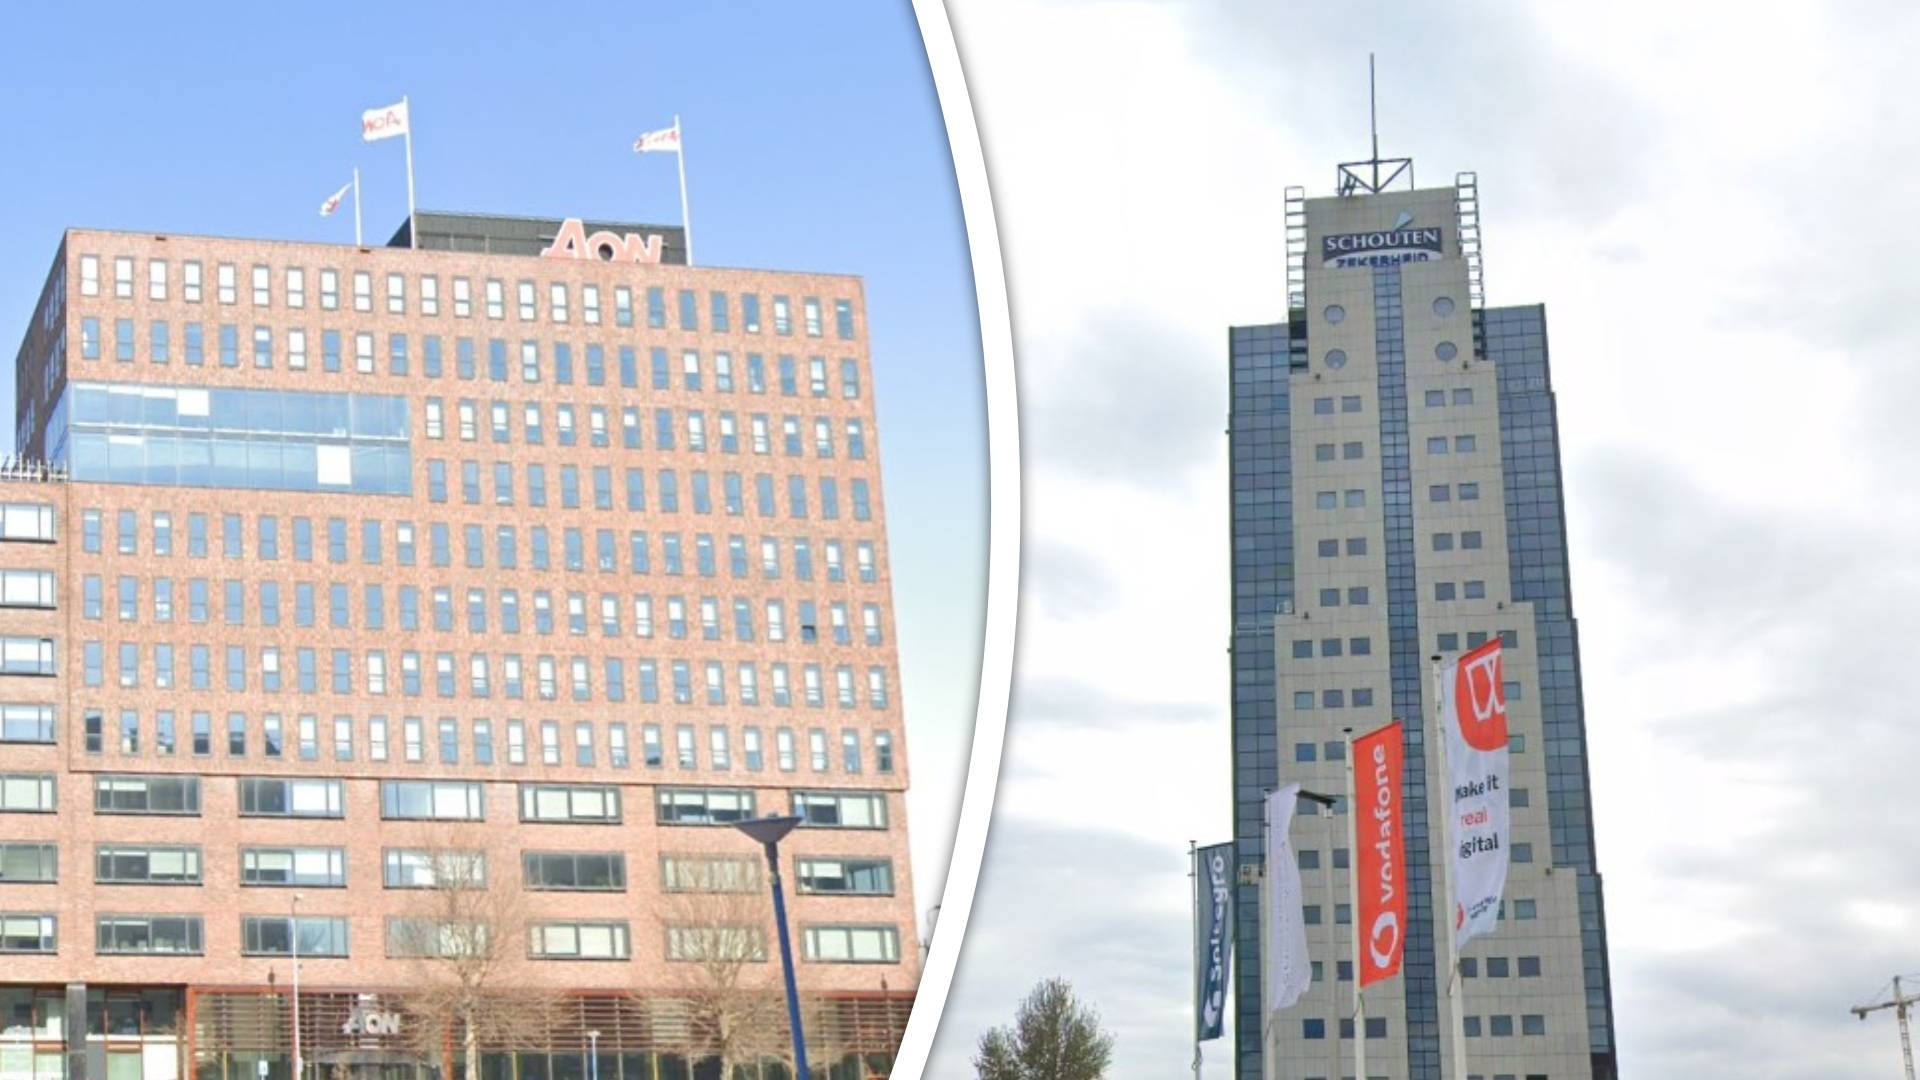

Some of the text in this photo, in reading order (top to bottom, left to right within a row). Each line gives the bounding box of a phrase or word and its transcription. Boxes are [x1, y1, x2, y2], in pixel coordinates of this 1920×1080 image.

[1327, 230, 1438, 250] SCHOUTEN
[1487, 774, 1499, 791] it
[1374, 743, 1394, 904] vodafone
[1461, 807, 1486, 825] real
